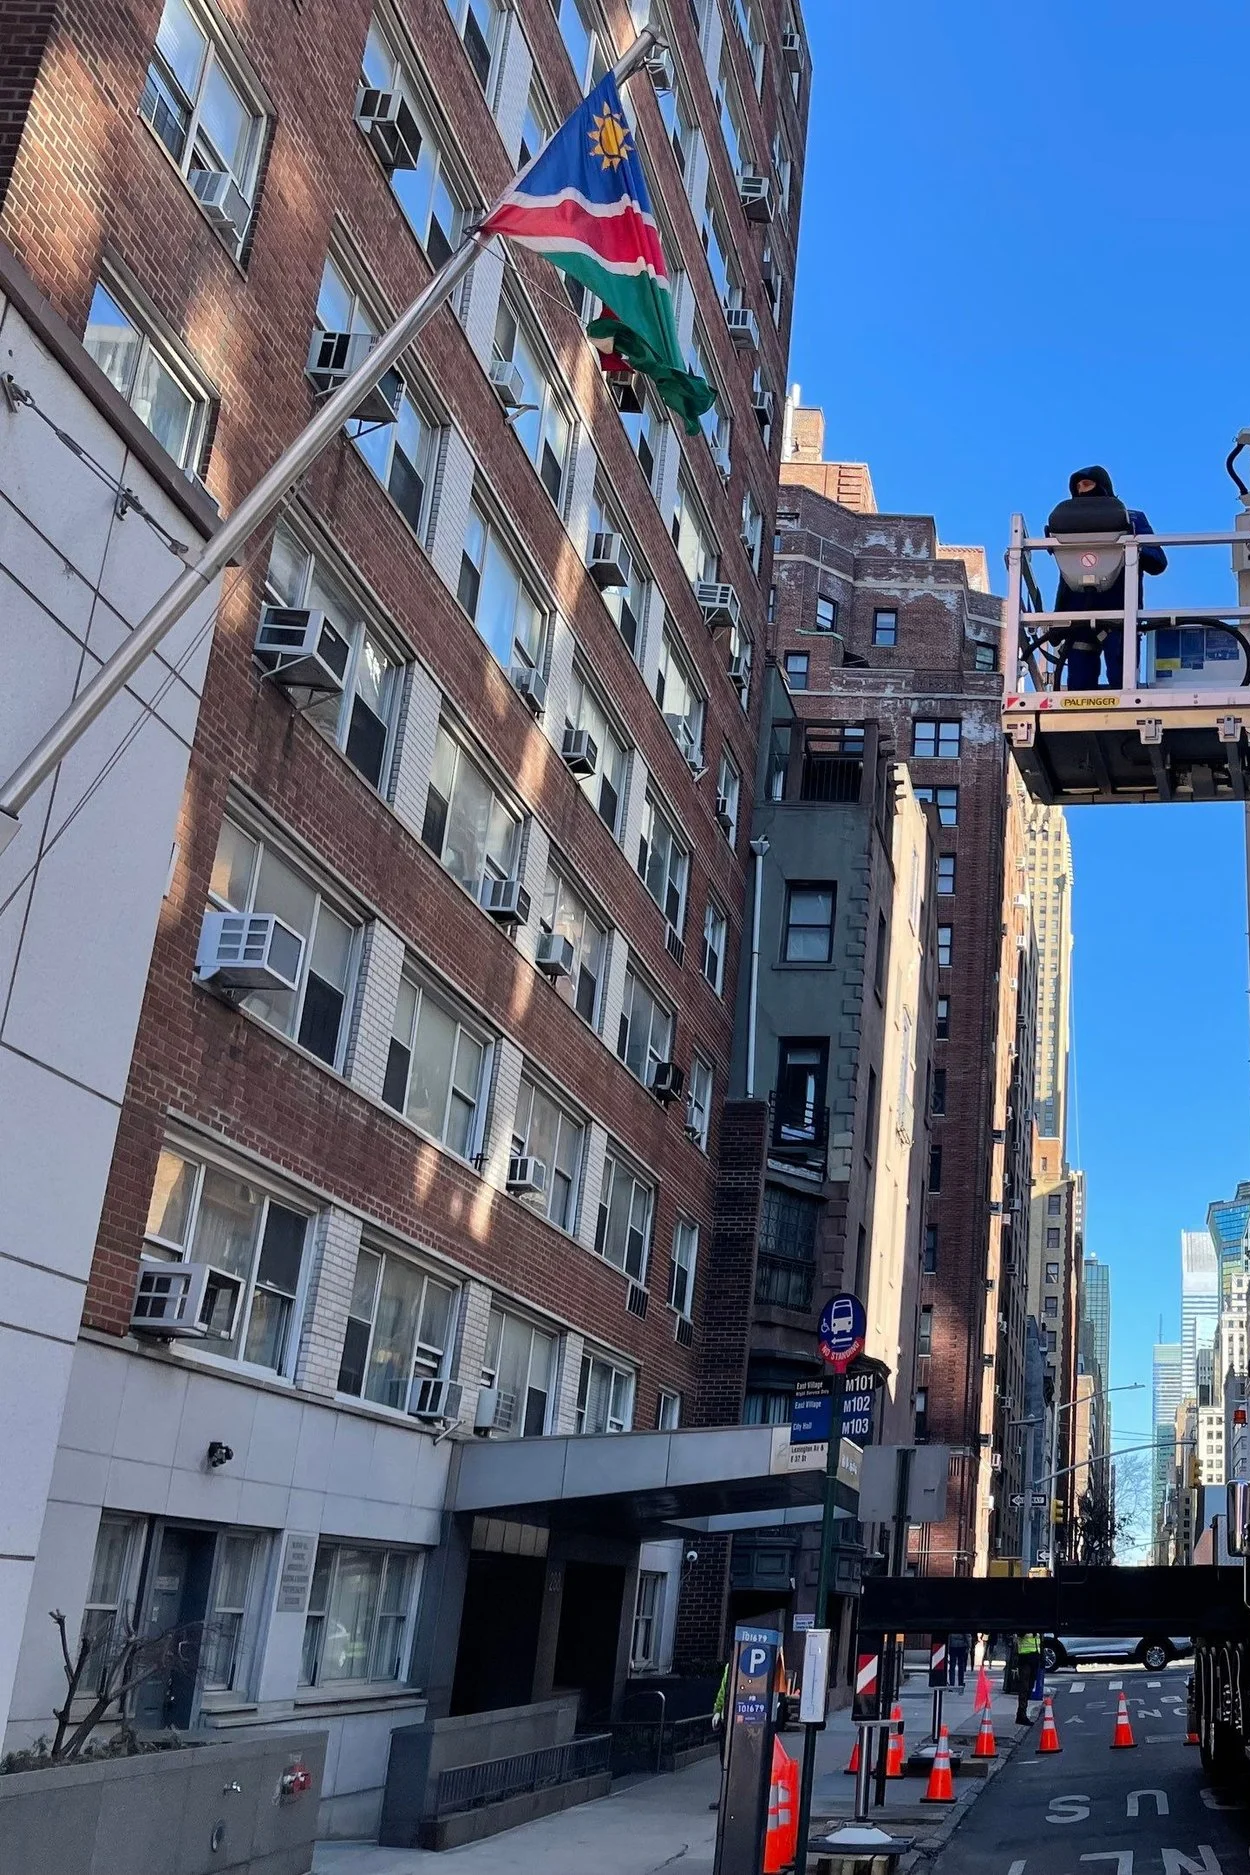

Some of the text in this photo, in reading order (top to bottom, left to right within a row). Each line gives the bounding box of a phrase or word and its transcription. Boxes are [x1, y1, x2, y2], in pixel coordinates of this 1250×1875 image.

[1064, 697, 1116, 706] PALFINGER
[821, 1340, 861, 1361] NO STANDING
[796, 1381, 823, 1390] East Village
[845, 1373, 874, 1392] M101
[794, 1400, 822, 1409] East Village
[843, 1395, 870, 1413] M102
[792, 1422, 813, 1432] City Hall
[841, 1418, 869, 1435] M103
[749, 1648, 766, 1674] P
[738, 1704, 765, 1713] 101679
